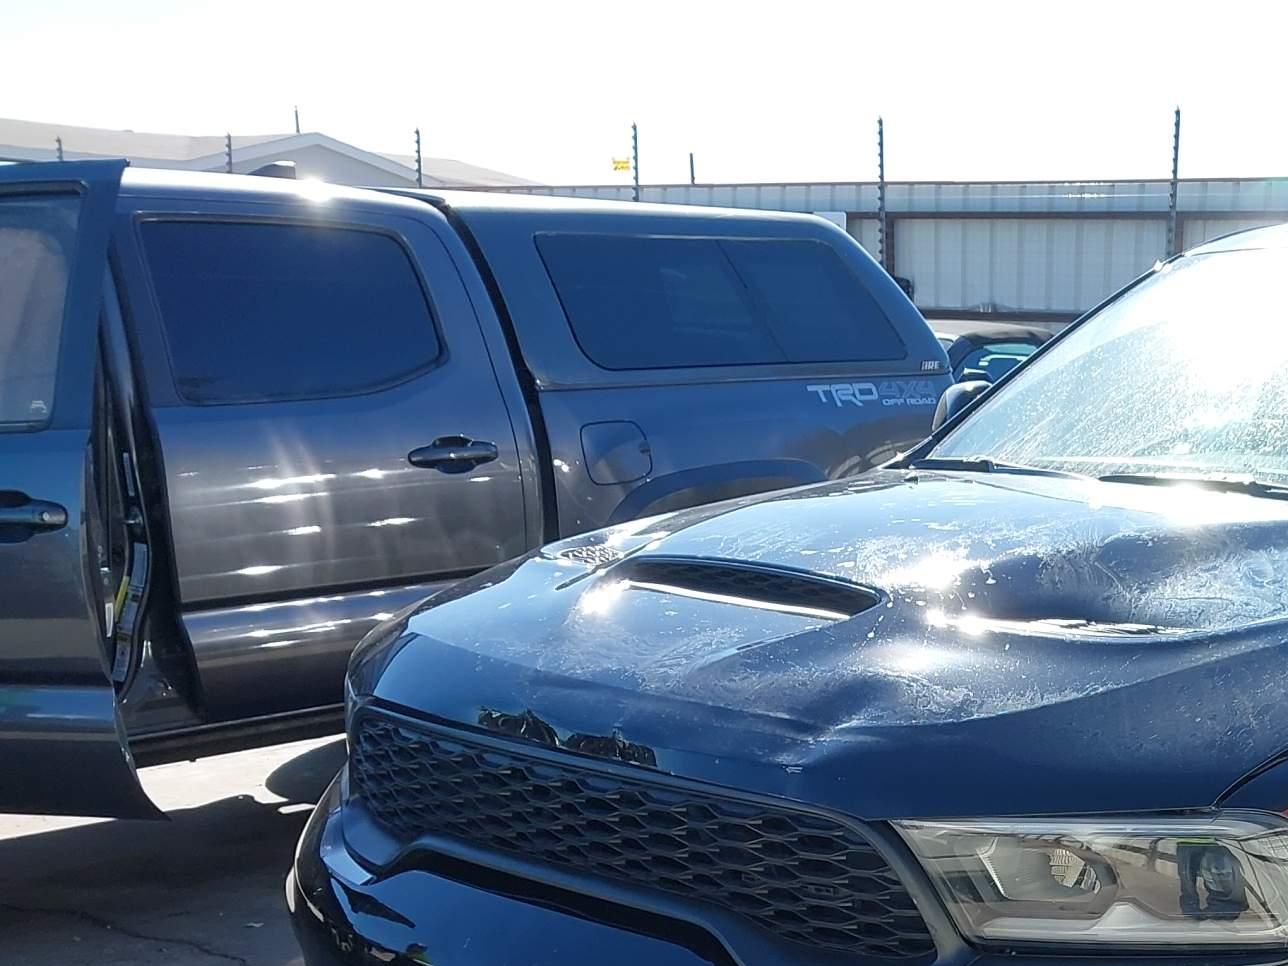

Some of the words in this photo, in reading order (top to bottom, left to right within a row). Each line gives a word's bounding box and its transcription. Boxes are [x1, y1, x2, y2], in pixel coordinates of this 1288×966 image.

[806, 382, 878, 407] TRD
[882, 398, 905, 406] OFF
[906, 397, 937, 405] ROAD
